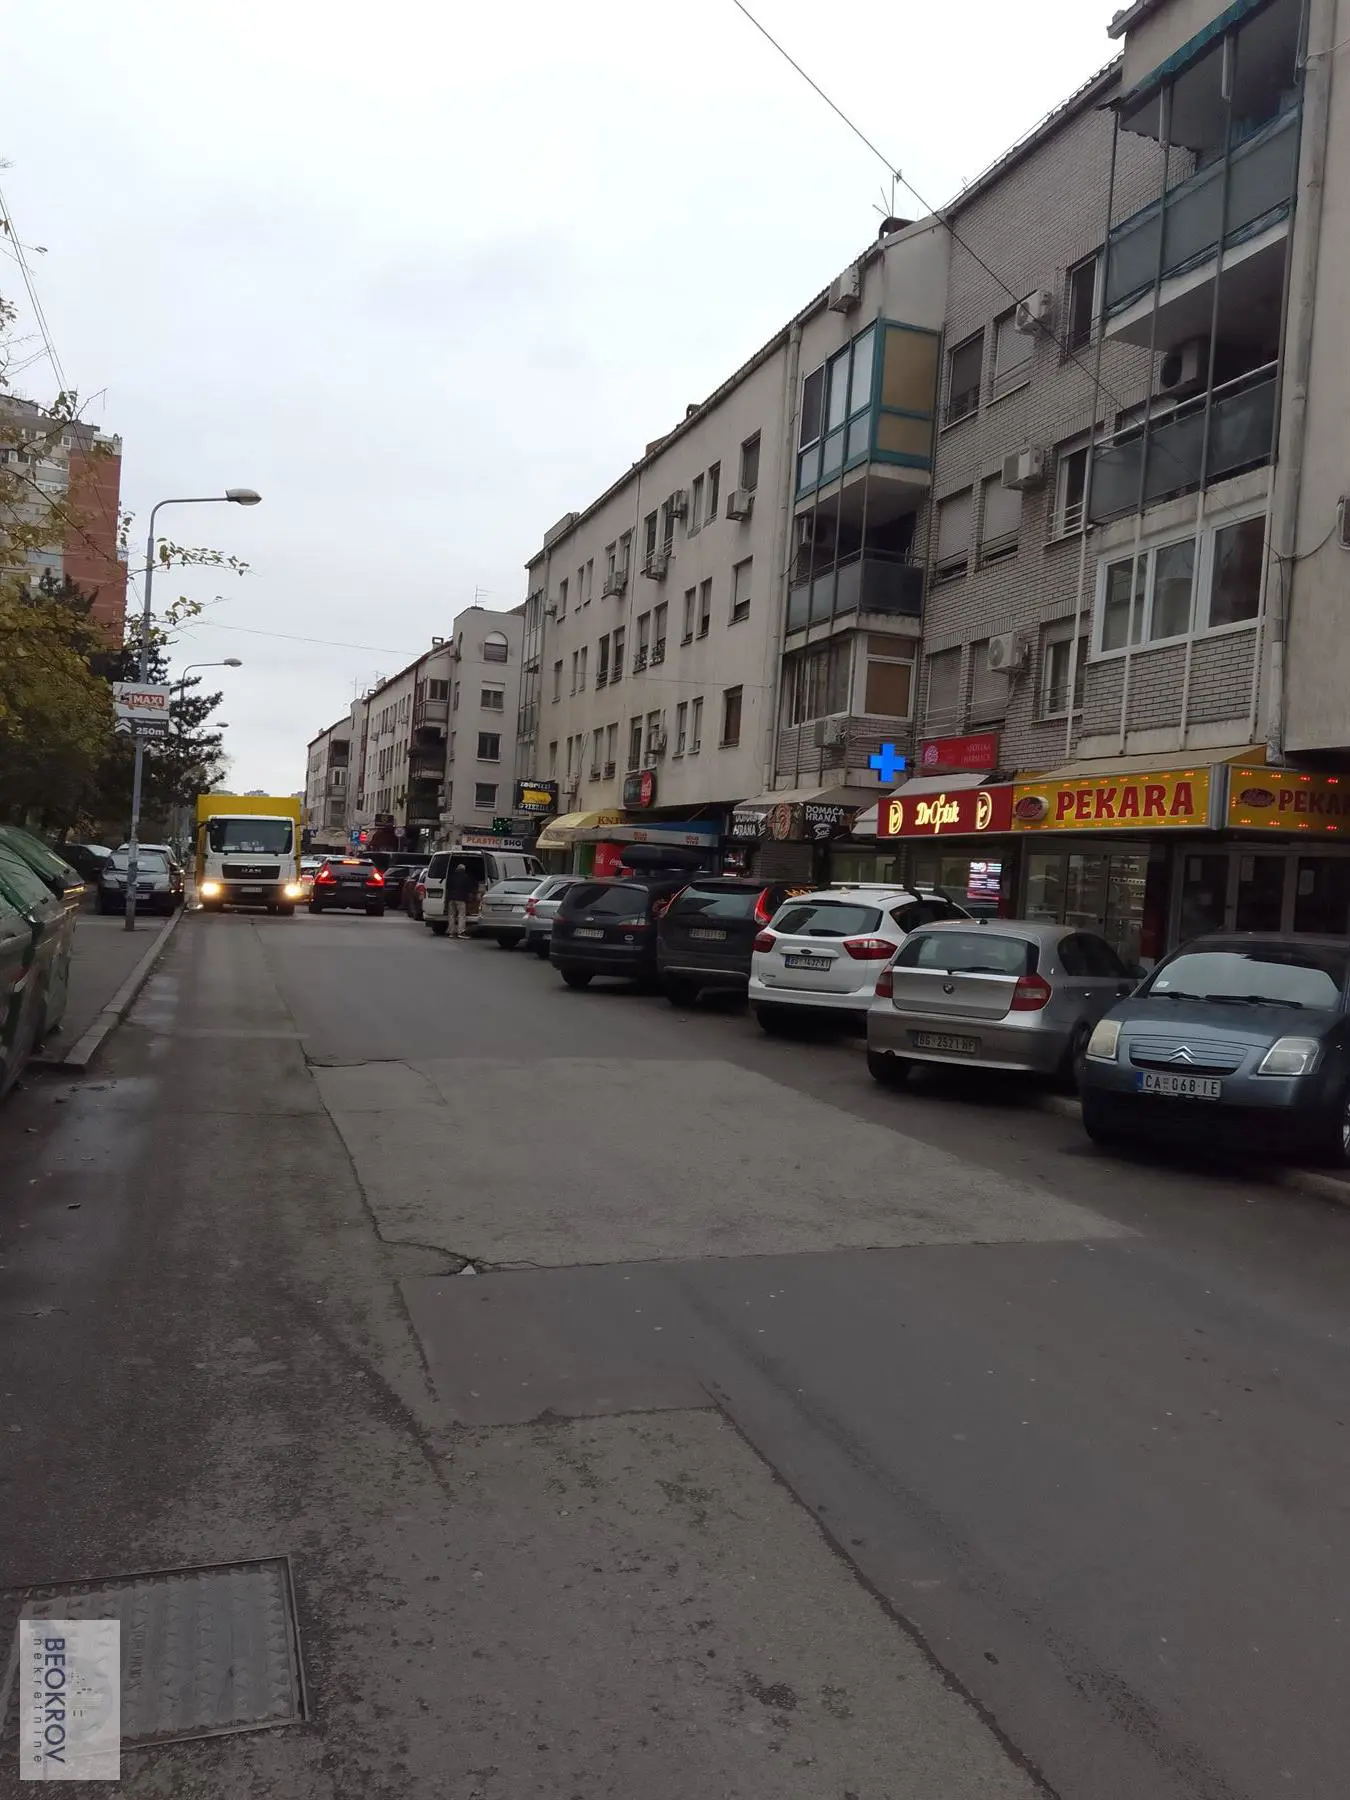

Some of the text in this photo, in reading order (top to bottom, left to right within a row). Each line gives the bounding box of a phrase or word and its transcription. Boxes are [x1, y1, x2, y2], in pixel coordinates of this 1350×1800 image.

[136, 727, 165, 736] 250m
[1056, 782, 1194, 821] PEKARA
[805, 813, 838, 823] HRANA
[1145, 1074, 1160, 1089] CA
